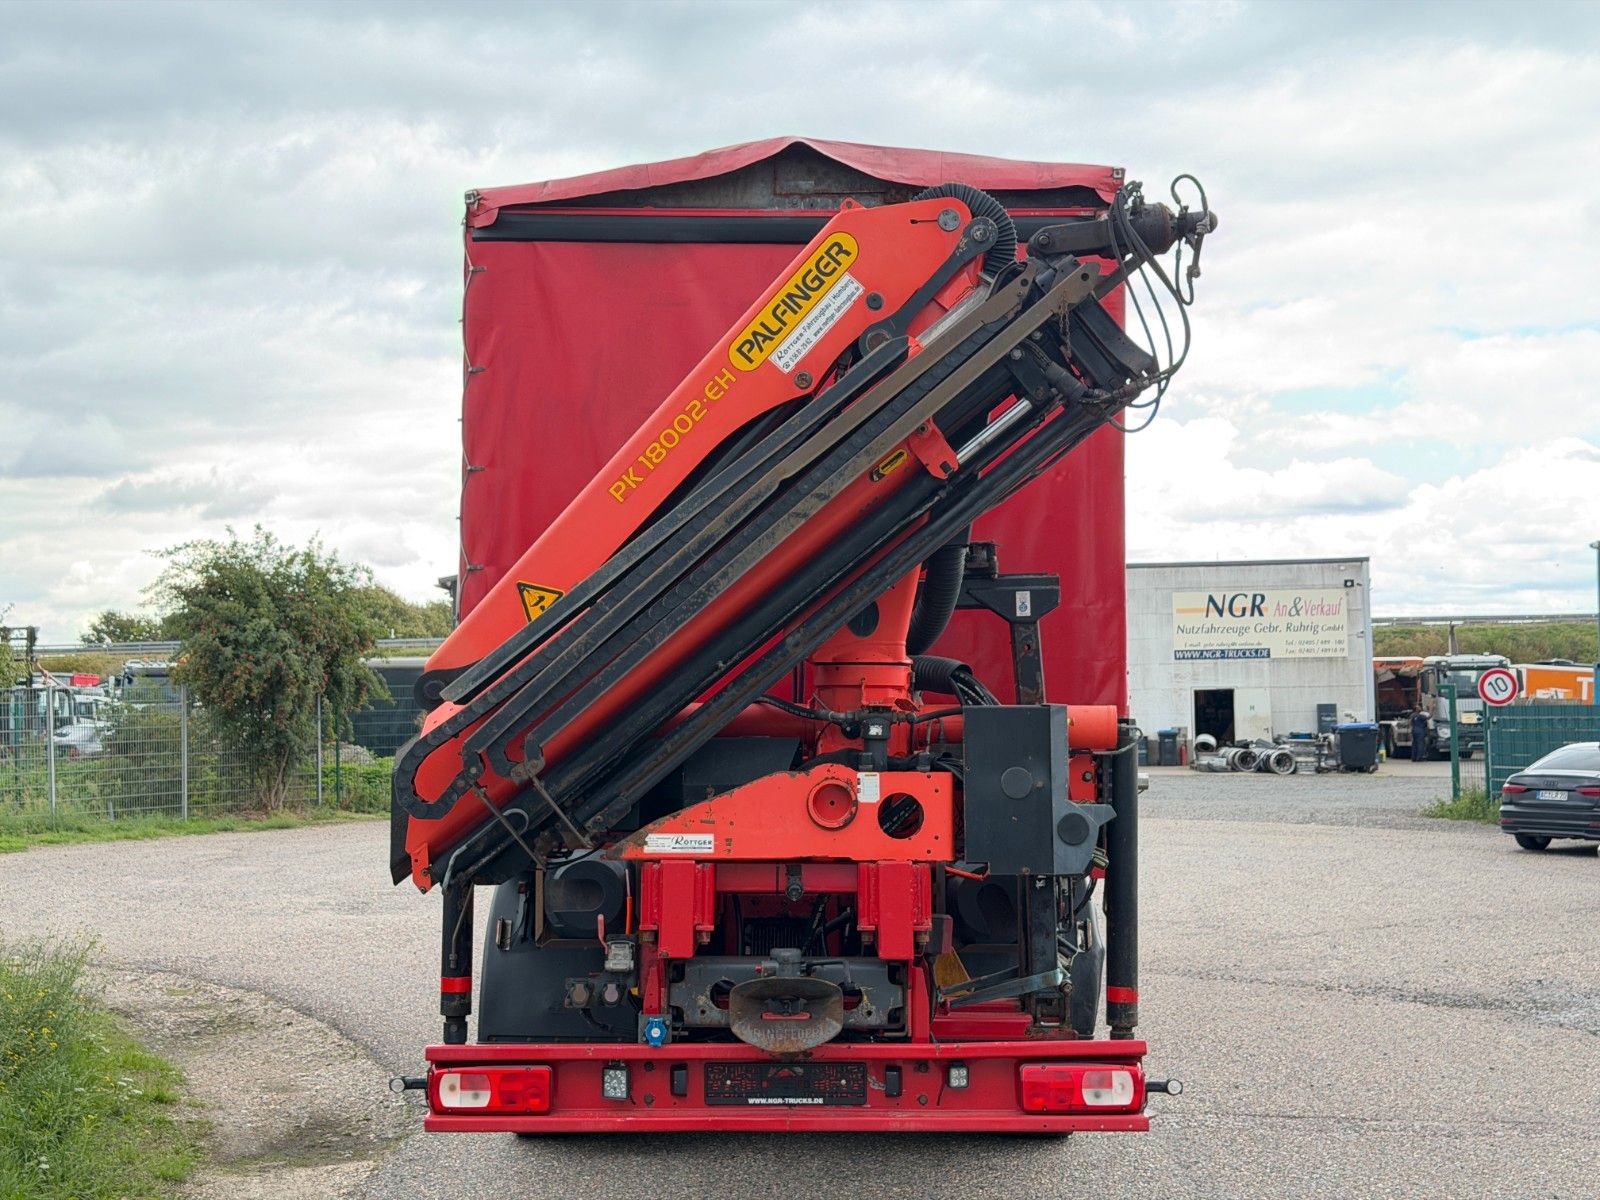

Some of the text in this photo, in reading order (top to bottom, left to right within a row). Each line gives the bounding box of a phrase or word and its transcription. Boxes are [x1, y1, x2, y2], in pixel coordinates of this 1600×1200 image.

[831, 278, 854, 300] Homberg
[736, 241, 852, 364] PALFINGER
[609, 466, 643, 502] PK
[1205, 593, 1266, 618] NGR
[1176, 624, 1251, 636] Nutzfahrzeuge
[1254, 622, 1282, 633] Gebr.
[1321, 624, 1344, 632] GmbH
[1175, 649, 1269, 659] WWW.NGR-TRUCKS.DE
[1488, 677, 1508, 695] 10
[748, 1097, 823, 1105] WWW.NGR-TRUCKS.DE
